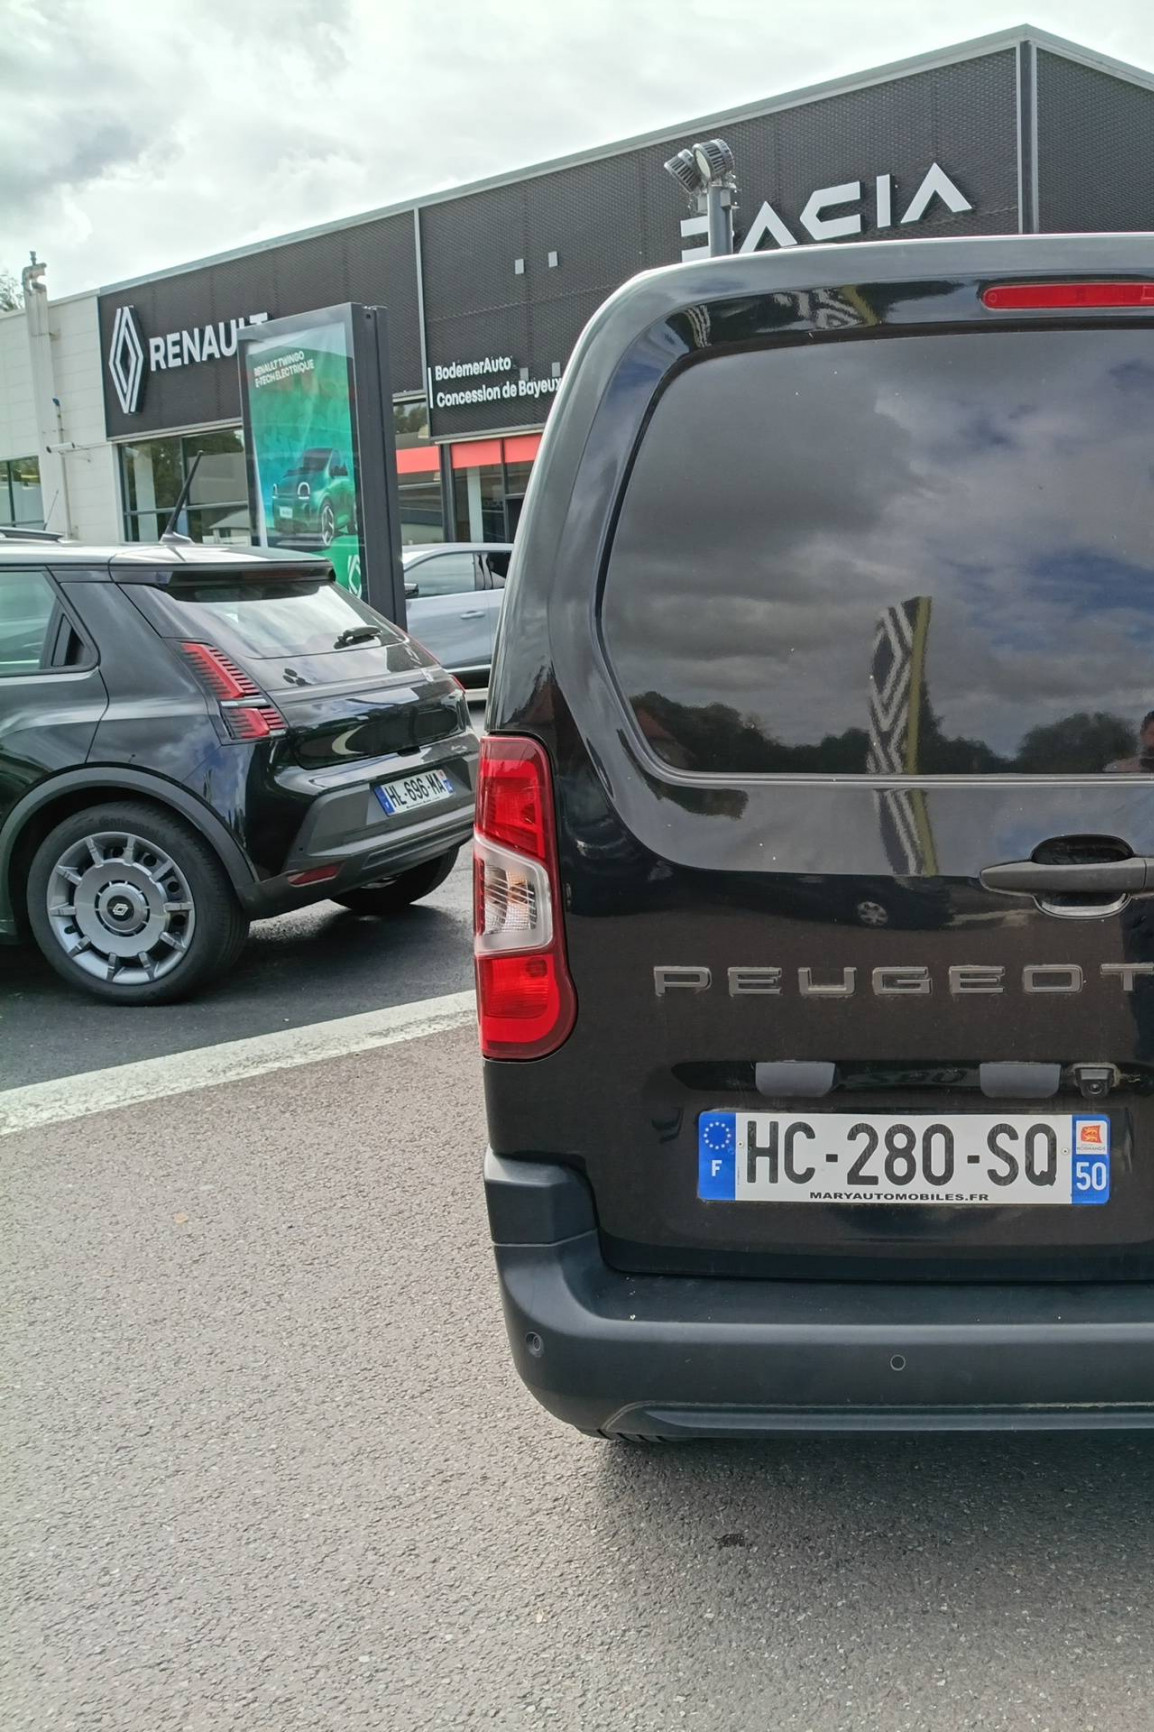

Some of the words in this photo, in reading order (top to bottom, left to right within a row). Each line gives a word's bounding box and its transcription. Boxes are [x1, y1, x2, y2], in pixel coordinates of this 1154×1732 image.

[435, 357, 512, 381] BodemerAuto
[436, 384, 501, 408] Concession
[502, 381, 517, 399] de
[518, 377, 562, 398] Bayeux
[711, 1159, 723, 1177] F
[747, 1120, 1057, 1187] HC-280-SQ
[1076, 1161, 1107, 1191] 50
[809, 1191, 990, 1202] MARYAUTOMOBILES.FR
